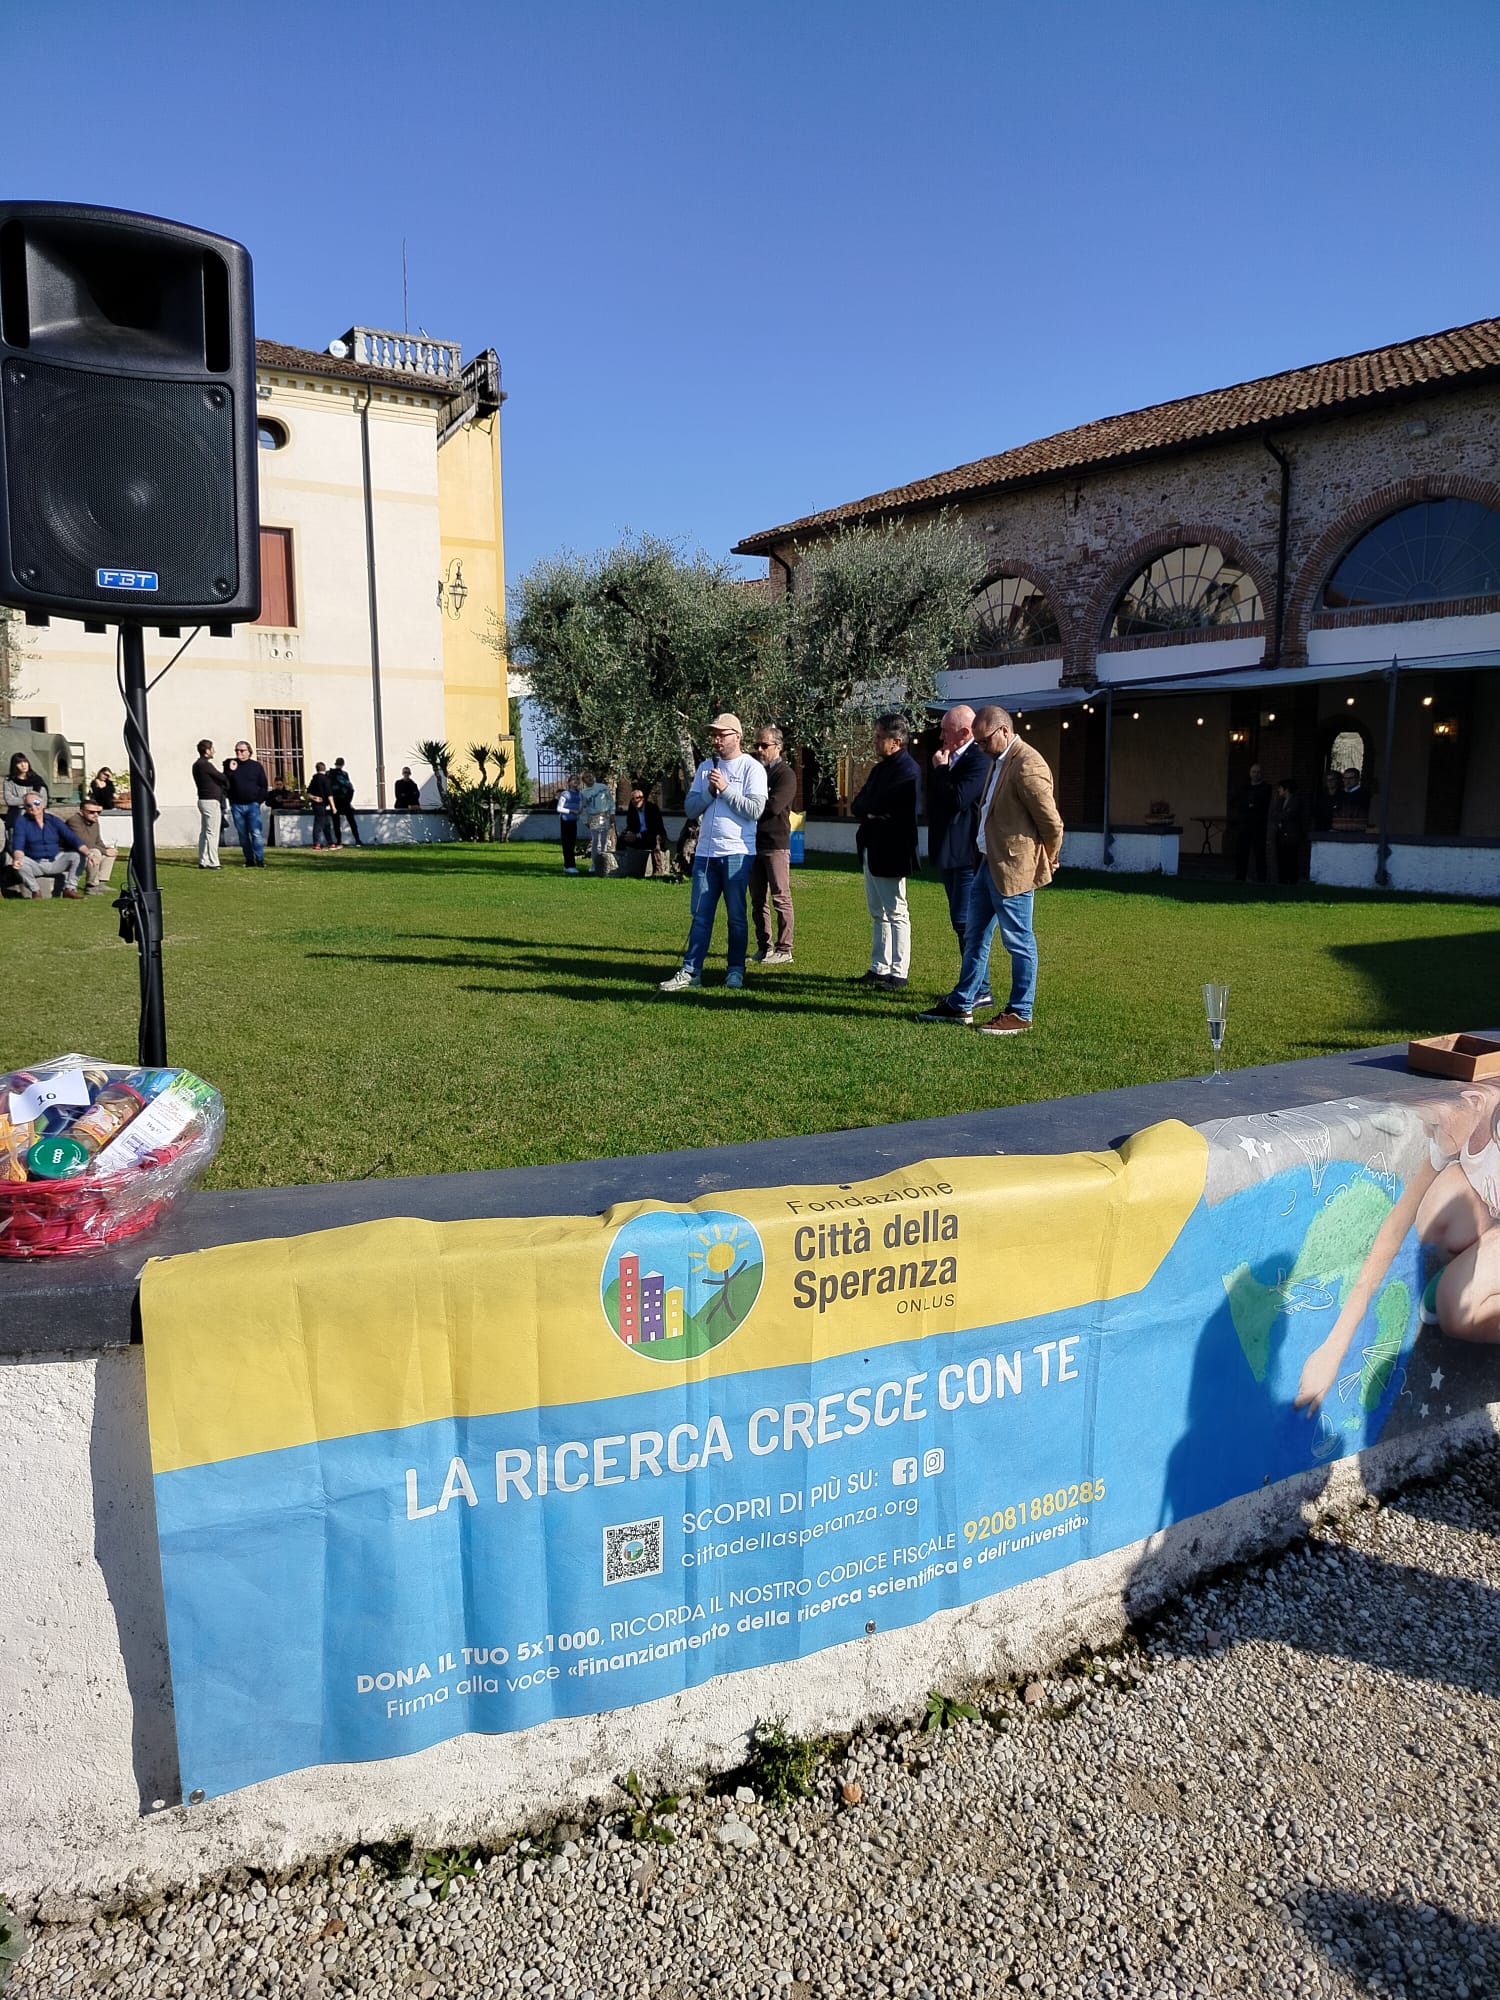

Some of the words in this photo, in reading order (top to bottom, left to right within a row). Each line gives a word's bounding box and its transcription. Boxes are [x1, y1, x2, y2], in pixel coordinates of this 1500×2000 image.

[103, 571, 153, 588] FBT
[37, 1092, 57, 1106] 10
[786, 1179, 954, 1216] Fondazione
[794, 1217, 871, 1263] Città
[883, 1208, 959, 1248] della
[793, 1255, 957, 1313] Speranza
[896, 1293, 955, 1314] ONLUS
[405, 1456, 479, 1520] LA
[495, 1415, 734, 1503] RICERCA
[747, 1372, 928, 1456] CRESCE
[937, 1350, 1022, 1411] CON
[1033, 1335, 1081, 1388] TE
[682, 1496, 771, 1534] SCOPRI
[779, 1490, 803, 1515] DI
[810, 1475, 841, 1508] PIÙ
[847, 1469, 879, 1494] SU:
[681, 1497, 919, 1567] cittadellasperanza.org
[357, 1662, 432, 1693] DONA
[438, 1652, 457, 1674] IL
[461, 1647, 510, 1665] TUO
[517, 1627, 605, 1661] 5x1000,
[610, 1604, 705, 1641] RICORDA
[709, 1595, 724, 1614] IL
[729, 1578, 812, 1608] NOSTRO
[817, 1552, 887, 1588] CODICE
[893, 1533, 956, 1567] FISCALE
[963, 1478, 1106, 1544] 92081880285
[387, 1686, 449, 1718] Firma
[456, 1676, 499, 1695] alla
[506, 1664, 561, 1692] voce
[567, 1622, 731, 1677] «Finanziamento
[736, 1610, 790, 1633] della
[797, 1588, 862, 1624] ricerca
[867, 1559, 958, 1598] scientifica
[962, 1557, 973, 1570] e
